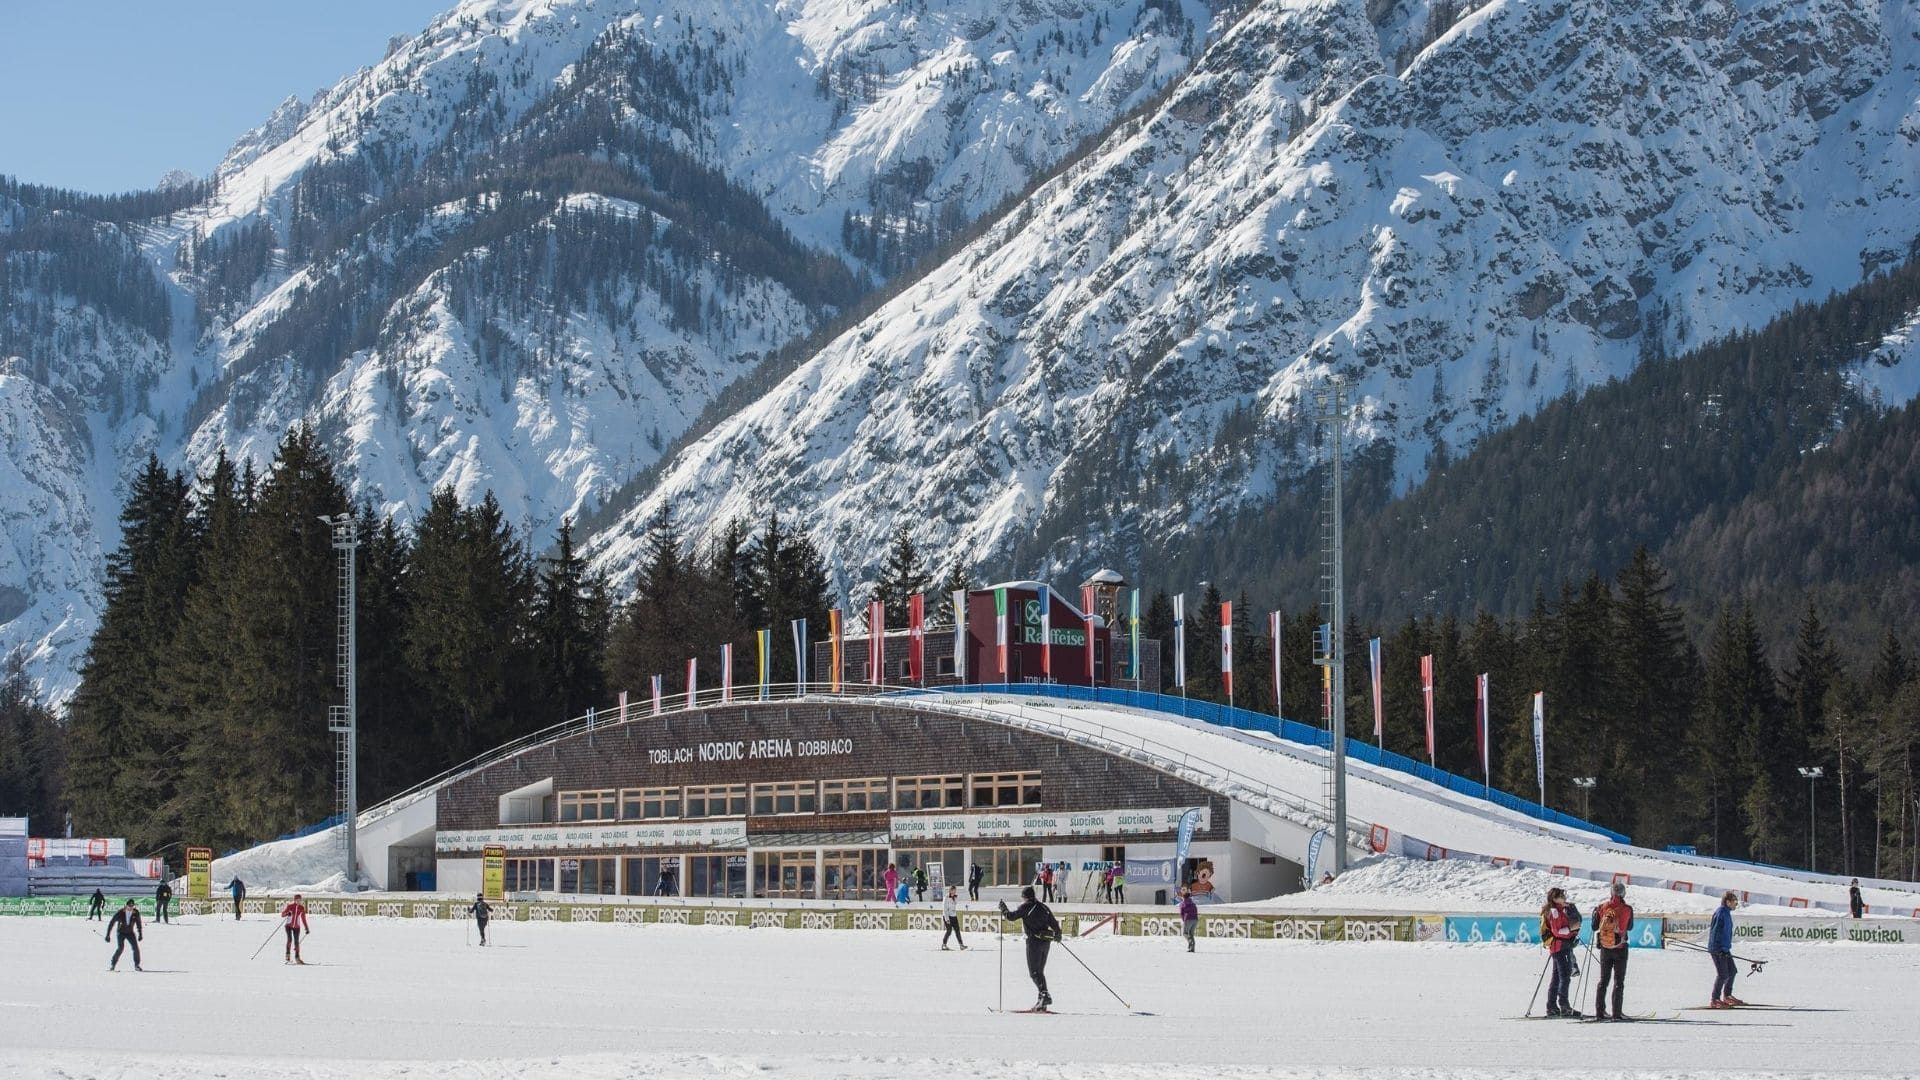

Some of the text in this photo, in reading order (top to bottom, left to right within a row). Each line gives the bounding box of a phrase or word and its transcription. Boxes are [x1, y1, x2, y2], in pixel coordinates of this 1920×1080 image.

[1025, 627, 1084, 646] Raffeise
[649, 738, 853, 764] TOBLACH NORDIC ARENA DOBBIACO
[342, 902, 369, 916] FORST
[378, 902, 404, 918] FORST
[413, 903, 440, 919] FORST
[491, 905, 518, 921] FORST
[529, 906, 561, 921] FORST
[571, 907, 603, 922] FORST
[614, 908, 646, 923] FORST
[658, 908, 692, 924] FORST
[705, 910, 738, 926] FORST
[752, 911, 788, 928] FORST
[801, 912, 837, 929] FORST
[853, 912, 892, 930] FORST
[908, 913, 946, 931] FORST
[963, 914, 1001, 932] FORST
[1142, 917, 1184, 936] FORST
[1206, 918, 1254, 938] FORST
[1273, 919, 1325, 940] FORST
[1344, 920, 1399, 941] FORST
